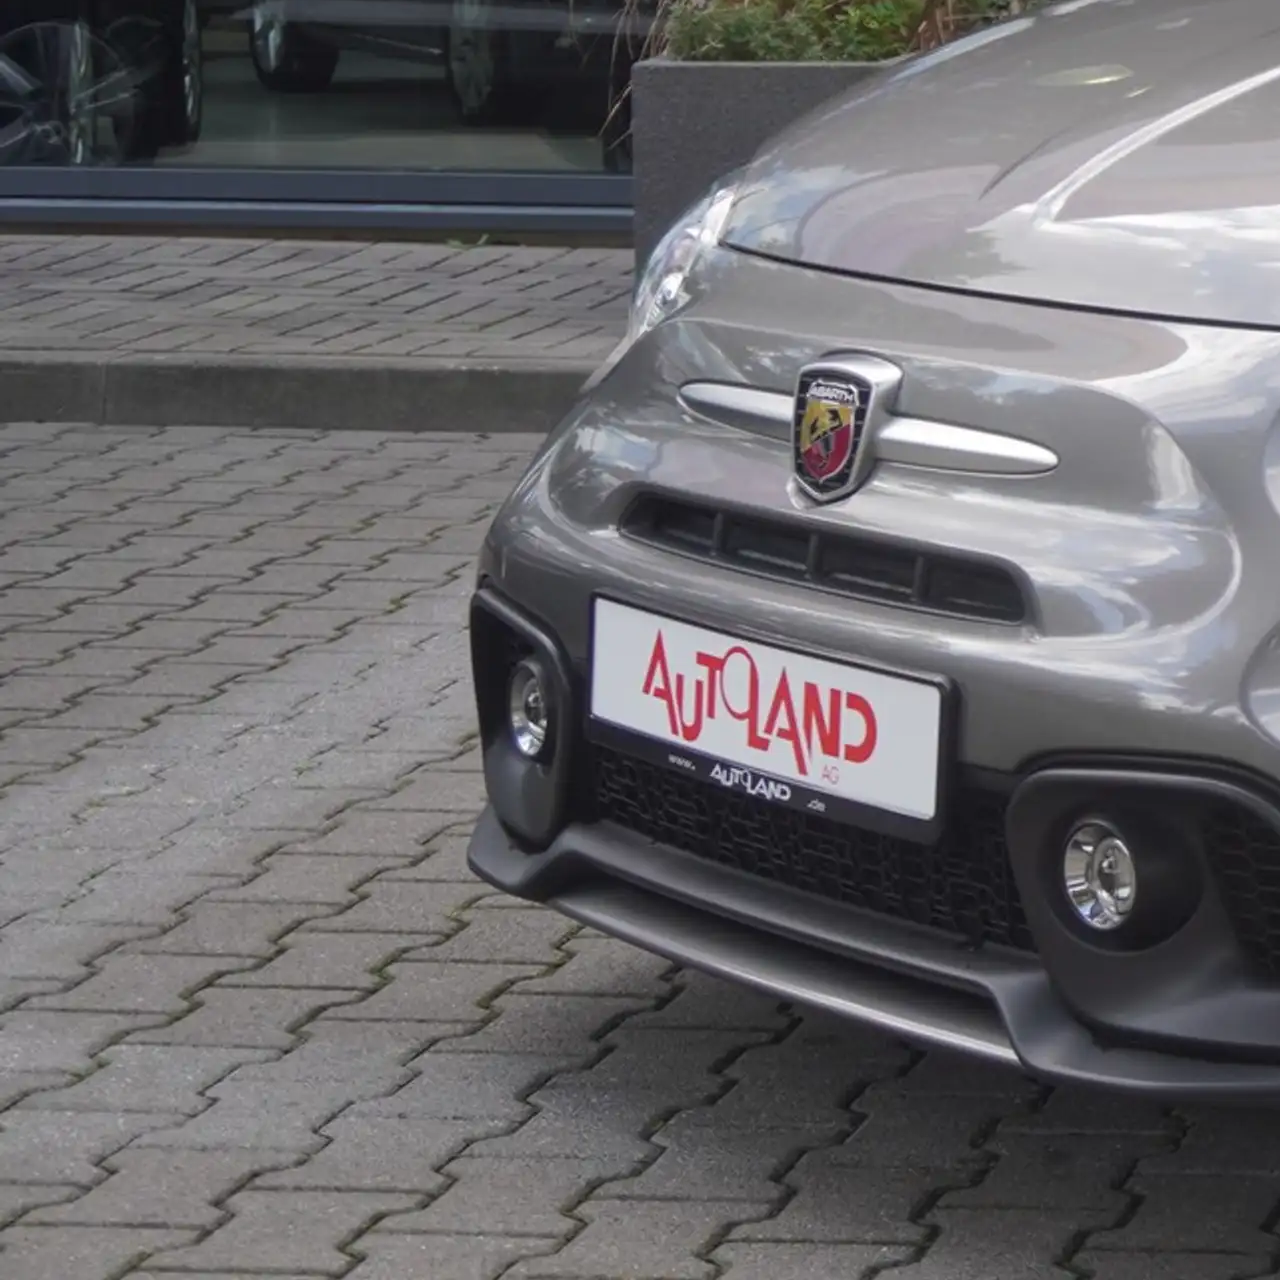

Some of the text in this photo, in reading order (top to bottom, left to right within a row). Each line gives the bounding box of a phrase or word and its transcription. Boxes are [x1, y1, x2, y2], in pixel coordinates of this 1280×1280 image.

[642, 628, 878, 776] AUTOLAND
[710, 763, 791, 801] AUTOLAND
[821, 764, 840, 785] AG
